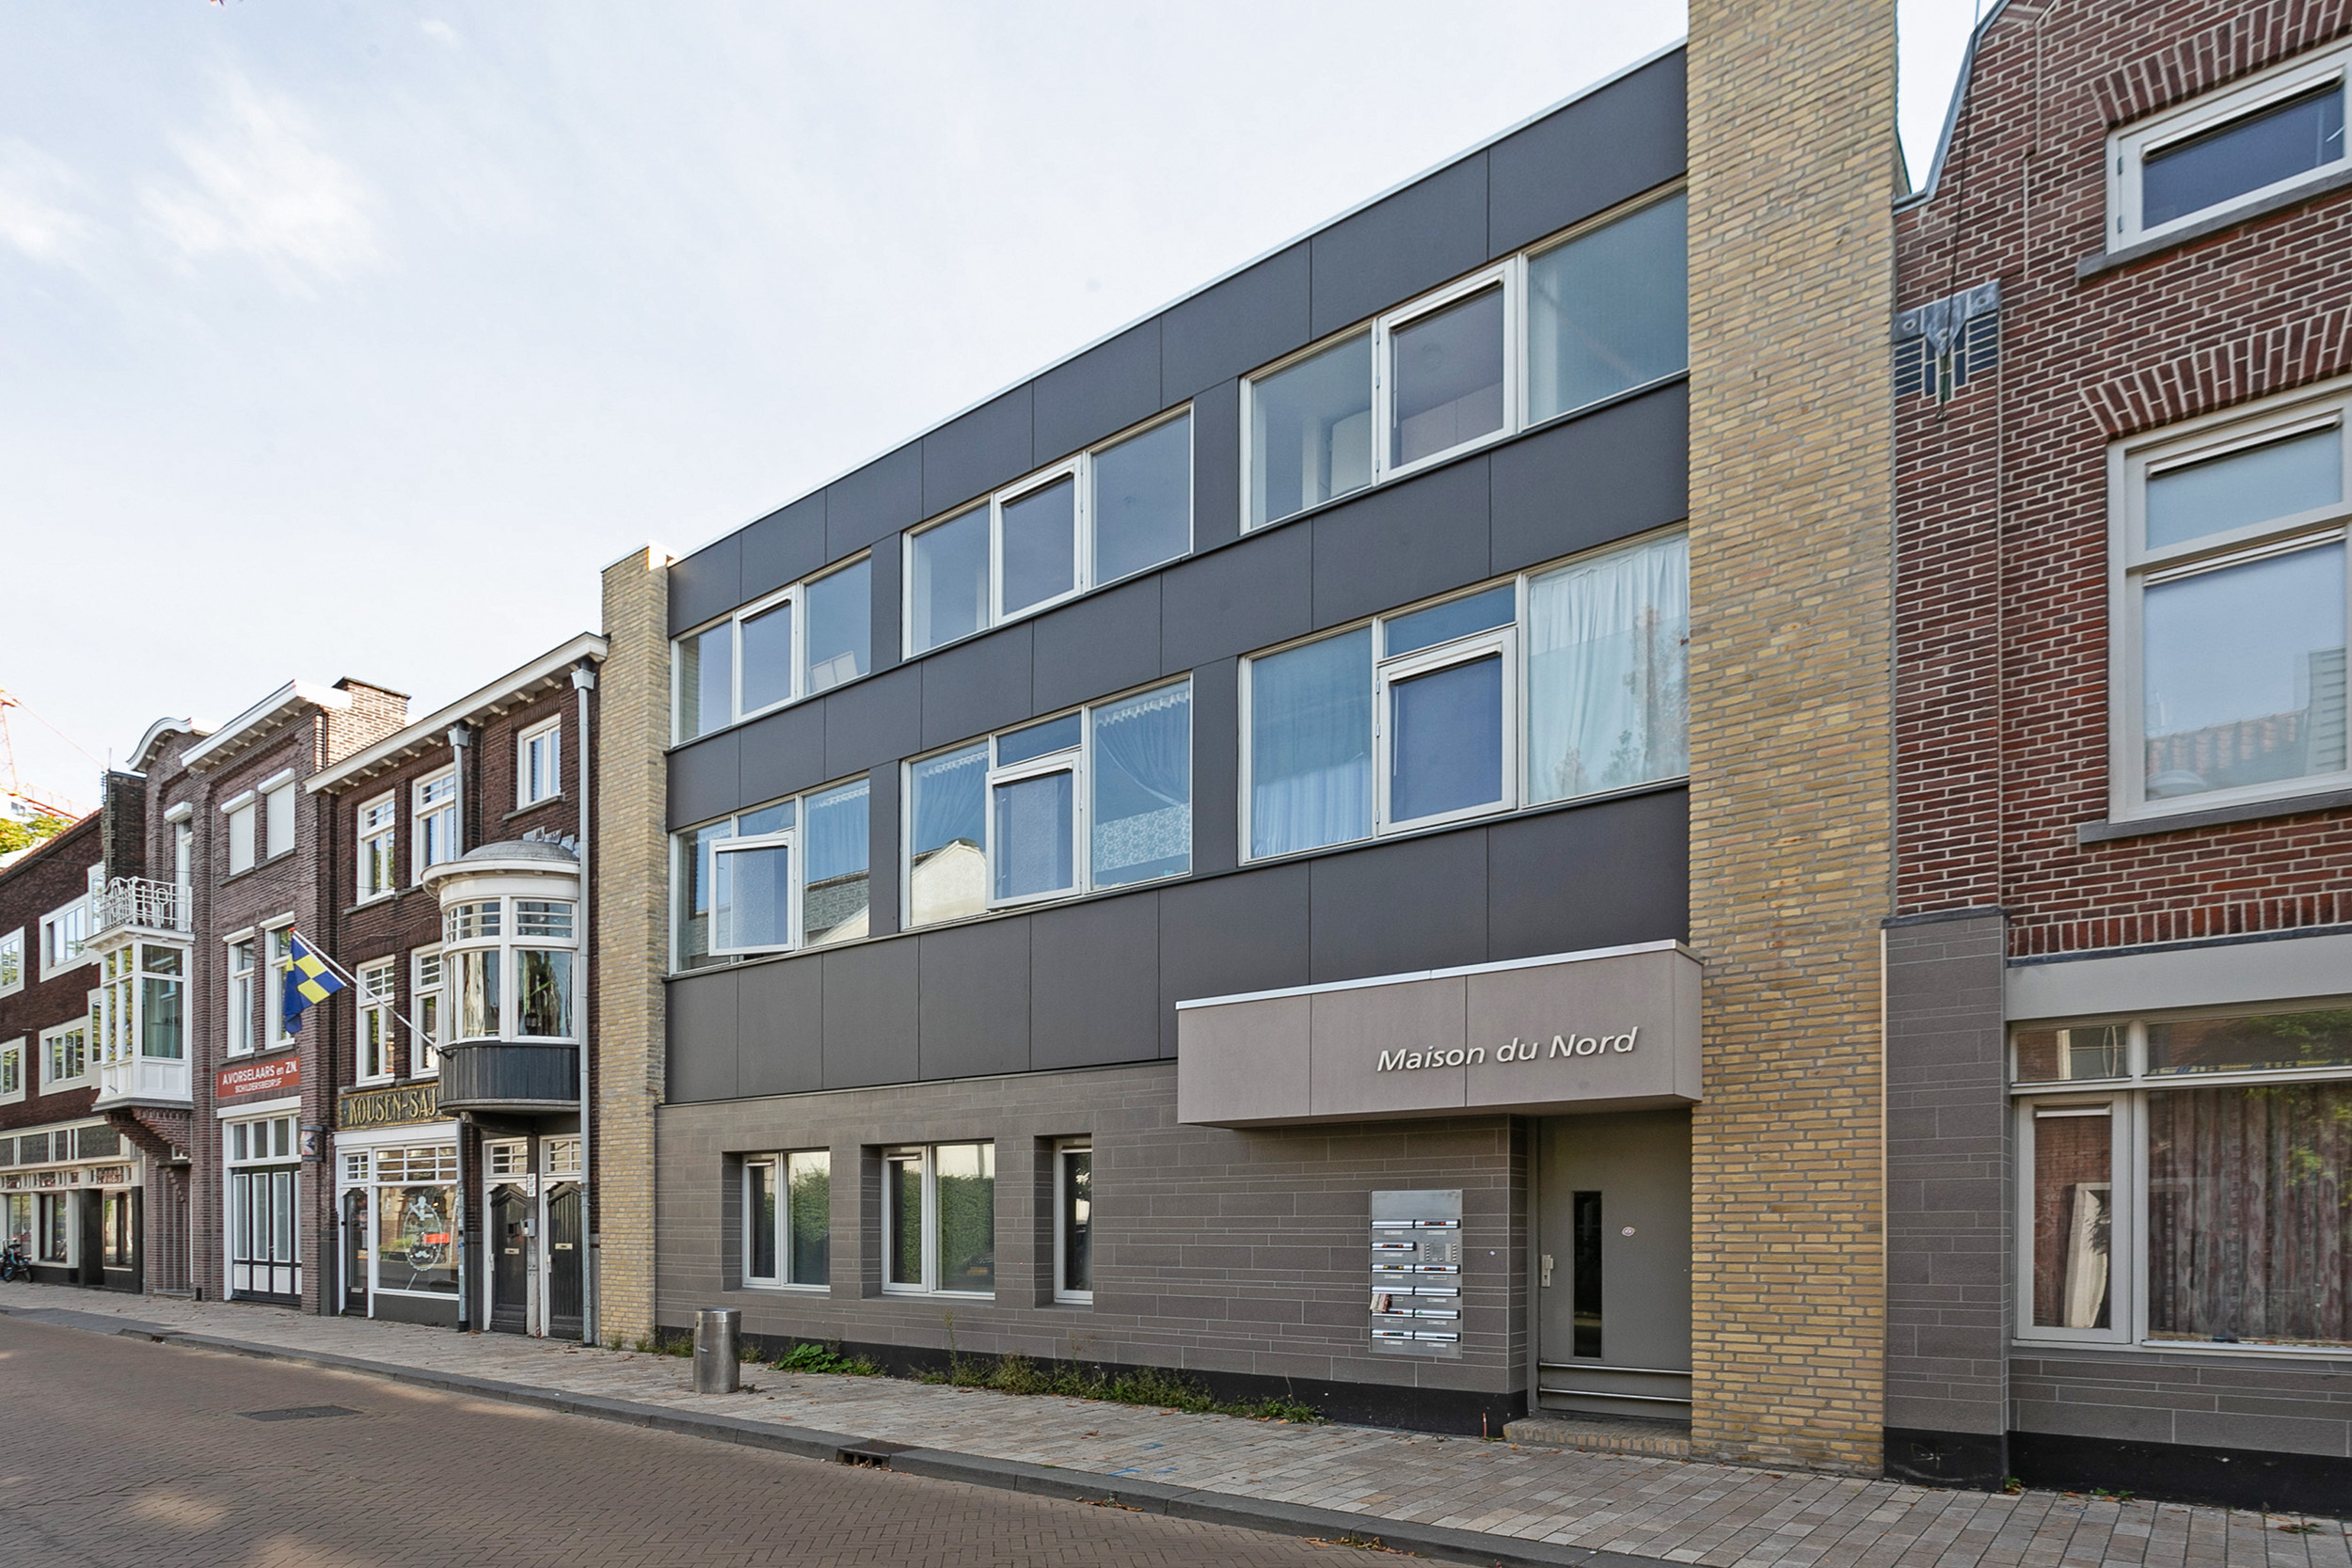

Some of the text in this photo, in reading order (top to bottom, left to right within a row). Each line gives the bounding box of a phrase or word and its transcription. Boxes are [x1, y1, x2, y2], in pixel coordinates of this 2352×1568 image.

[1376, 1025, 1639, 1072] Maison du Nord
[276, 1067, 284, 1076] en
